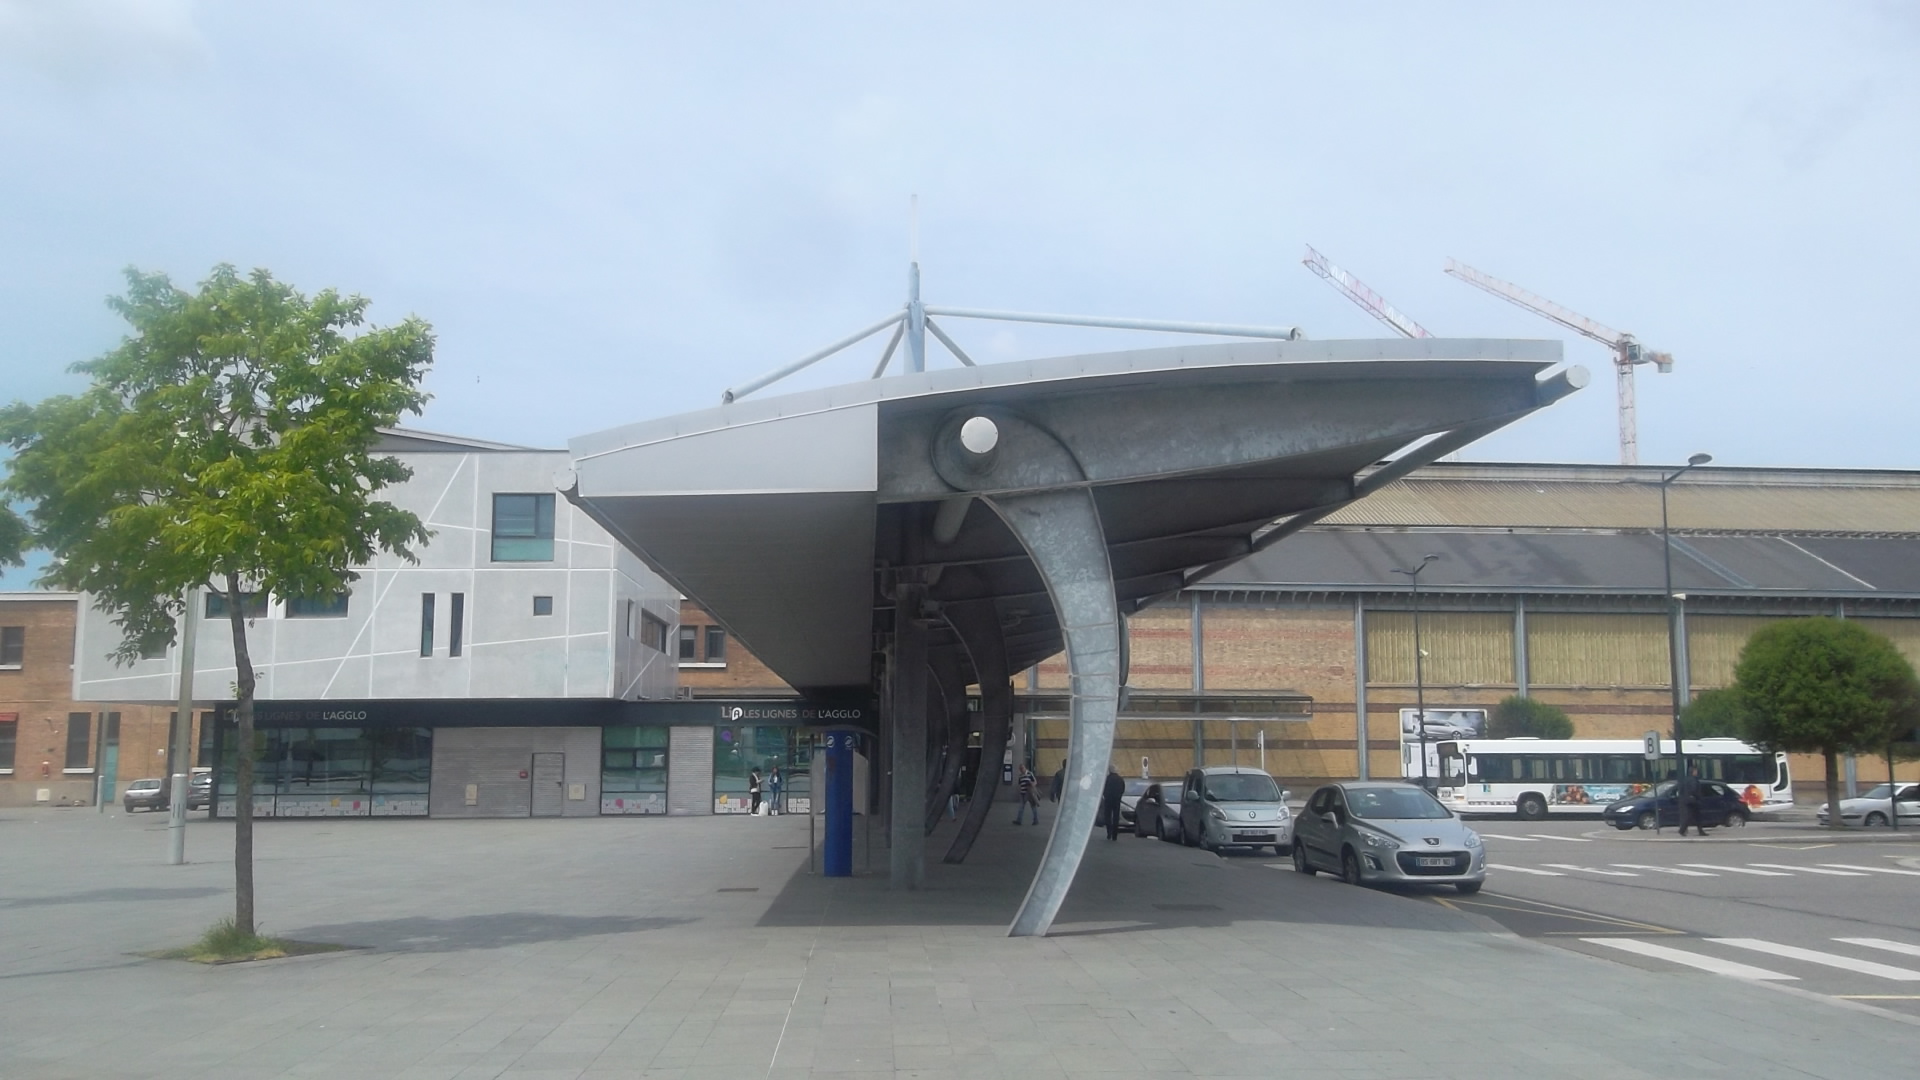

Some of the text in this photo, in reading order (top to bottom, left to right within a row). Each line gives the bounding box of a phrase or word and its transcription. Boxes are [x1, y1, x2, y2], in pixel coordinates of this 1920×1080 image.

[265, 711, 301, 721] LIGNES
[305, 711, 320, 720] DE
[323, 710, 367, 720] L'AGGLO
[744, 709, 760, 719] LES
[762, 709, 797, 719] LIGNES
[802, 709, 817, 719] DE
[818, 708, 861, 719] L'AGGLO
[1647, 736, 1654, 754] B
